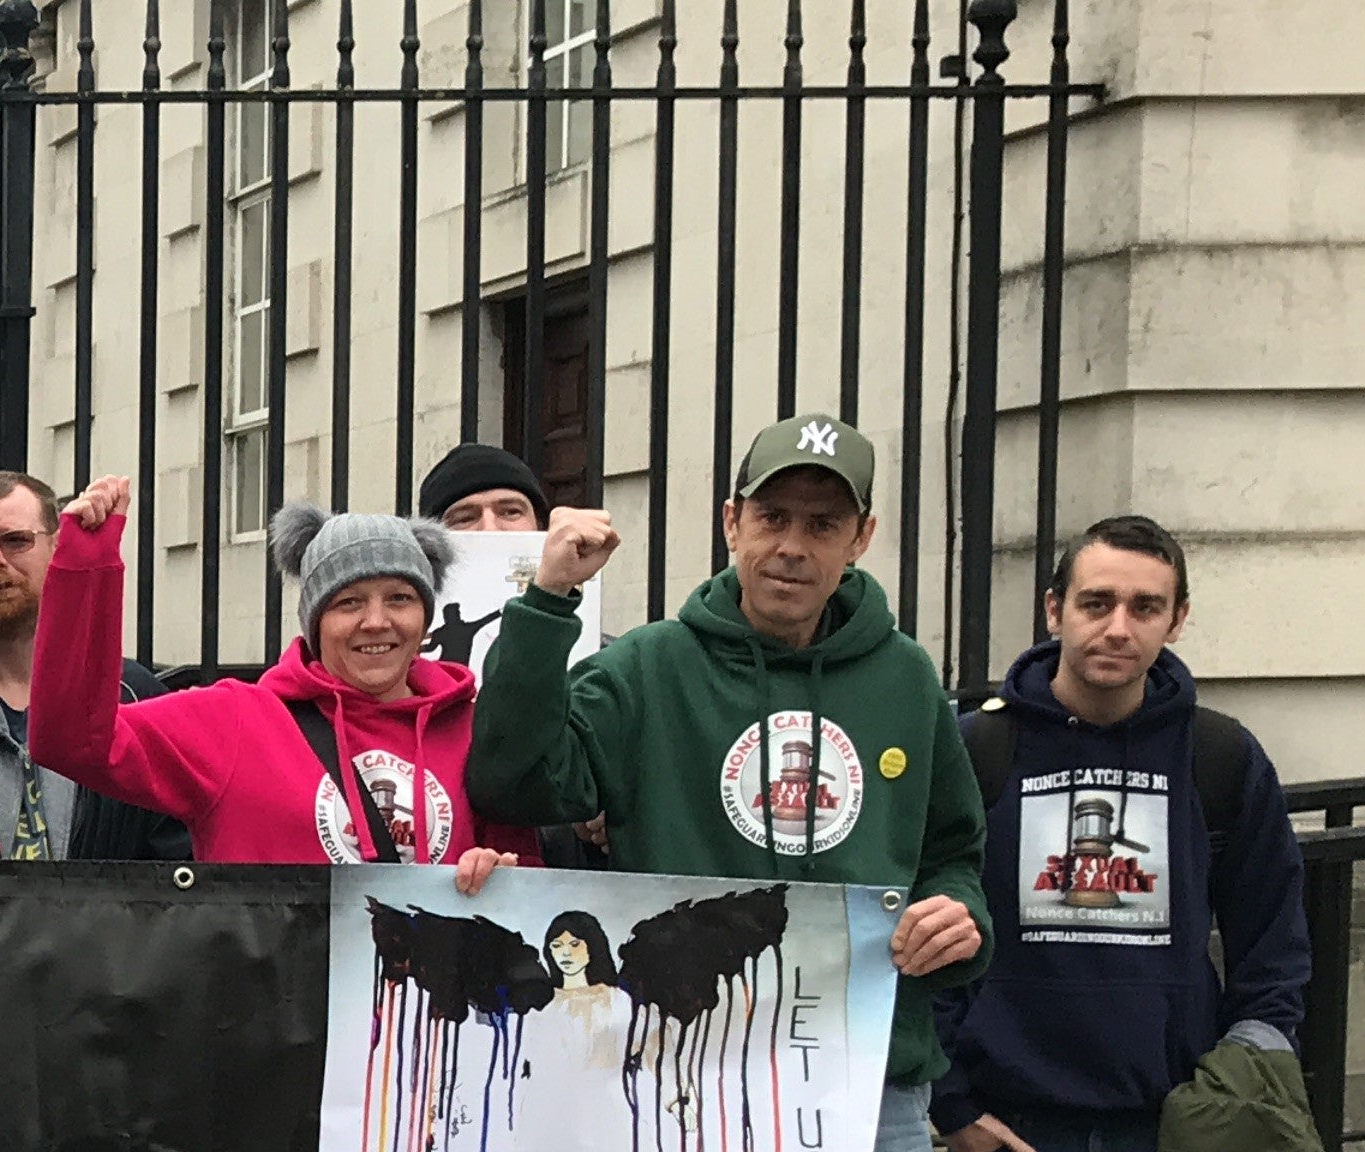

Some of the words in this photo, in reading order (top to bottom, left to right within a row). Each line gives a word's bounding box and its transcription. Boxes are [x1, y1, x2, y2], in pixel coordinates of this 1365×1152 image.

[796, 421, 839, 456] NY
[725, 727, 761, 780] NONC
[774, 715, 855, 760] CATHERS
[1021, 770, 1070, 792] NONCE
[1152, 773, 1168, 790] NI
[790, 966, 821, 1082] LET
